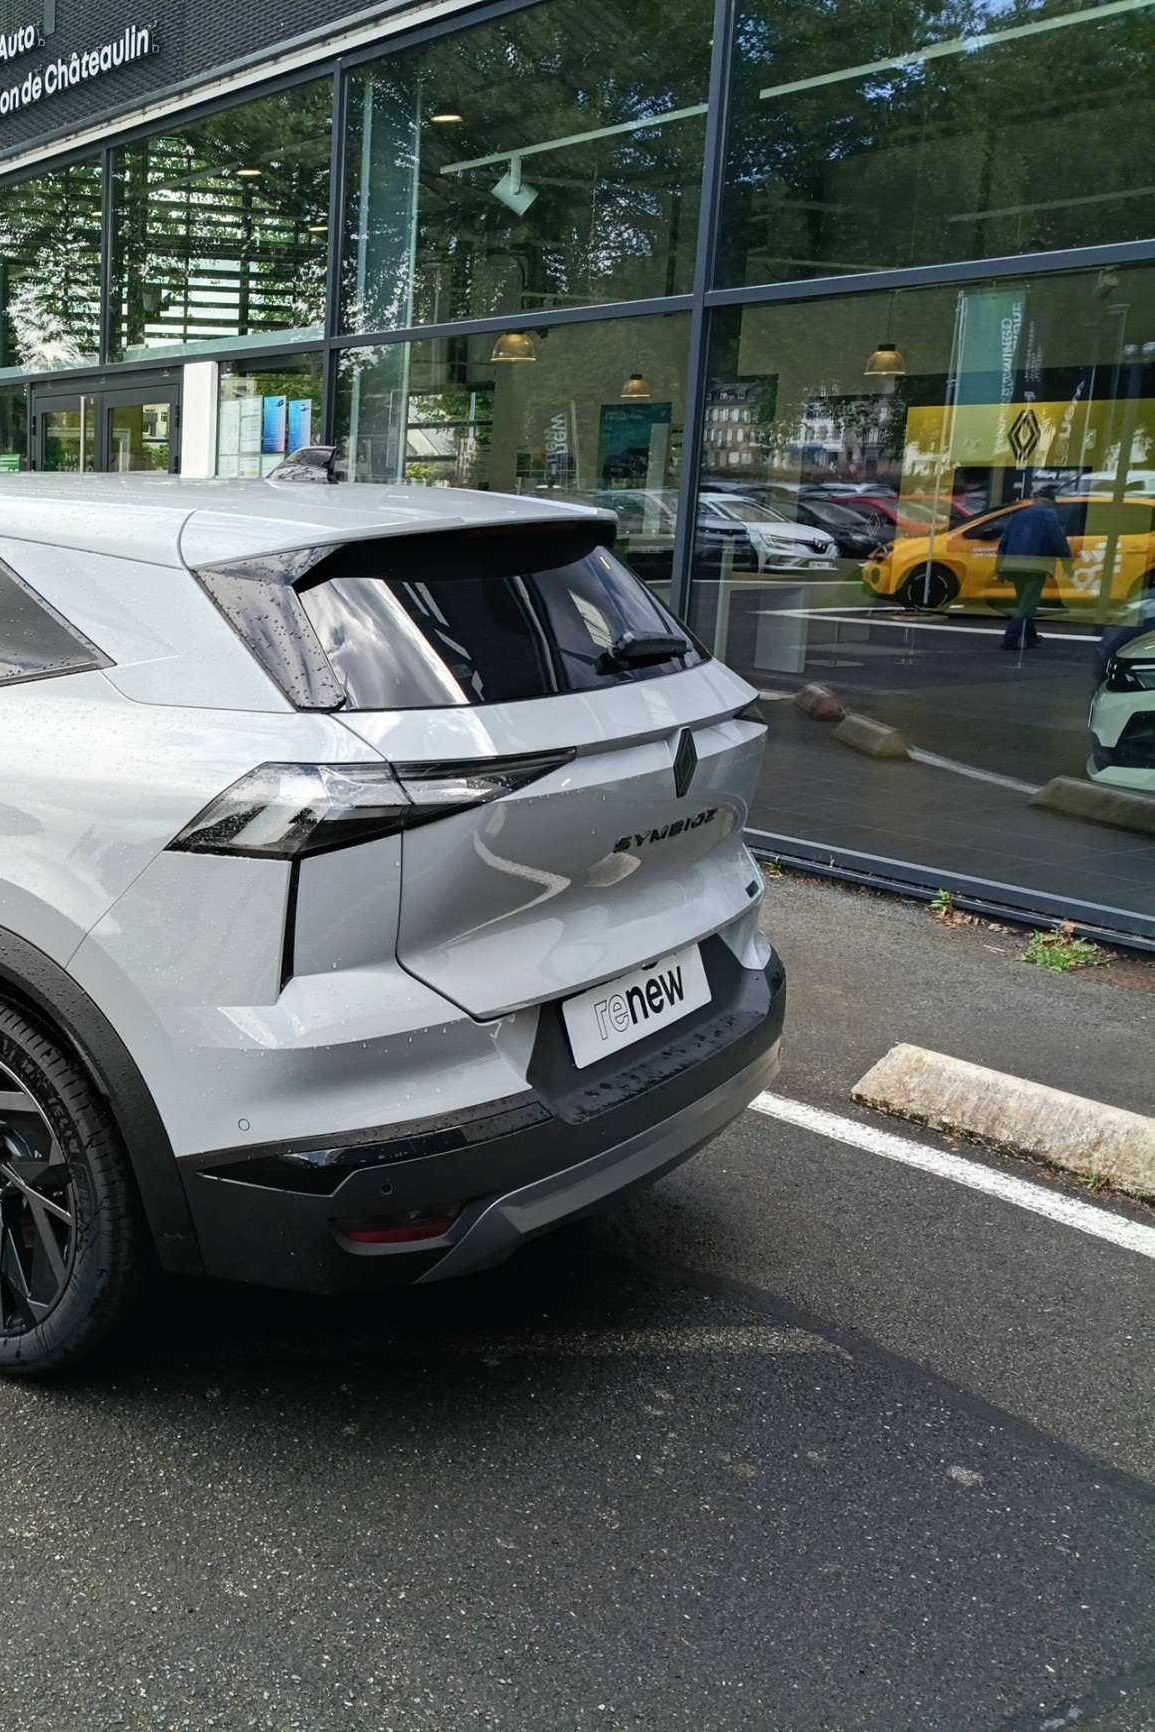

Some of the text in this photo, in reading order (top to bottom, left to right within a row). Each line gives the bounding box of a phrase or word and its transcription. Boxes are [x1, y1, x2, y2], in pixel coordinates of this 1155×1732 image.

[21, 73, 42, 103] de
[44, 25, 149, 94] Châteaulin
[612, 807, 719, 853] SYMBIOZ
[593, 965, 684, 1041] renew
